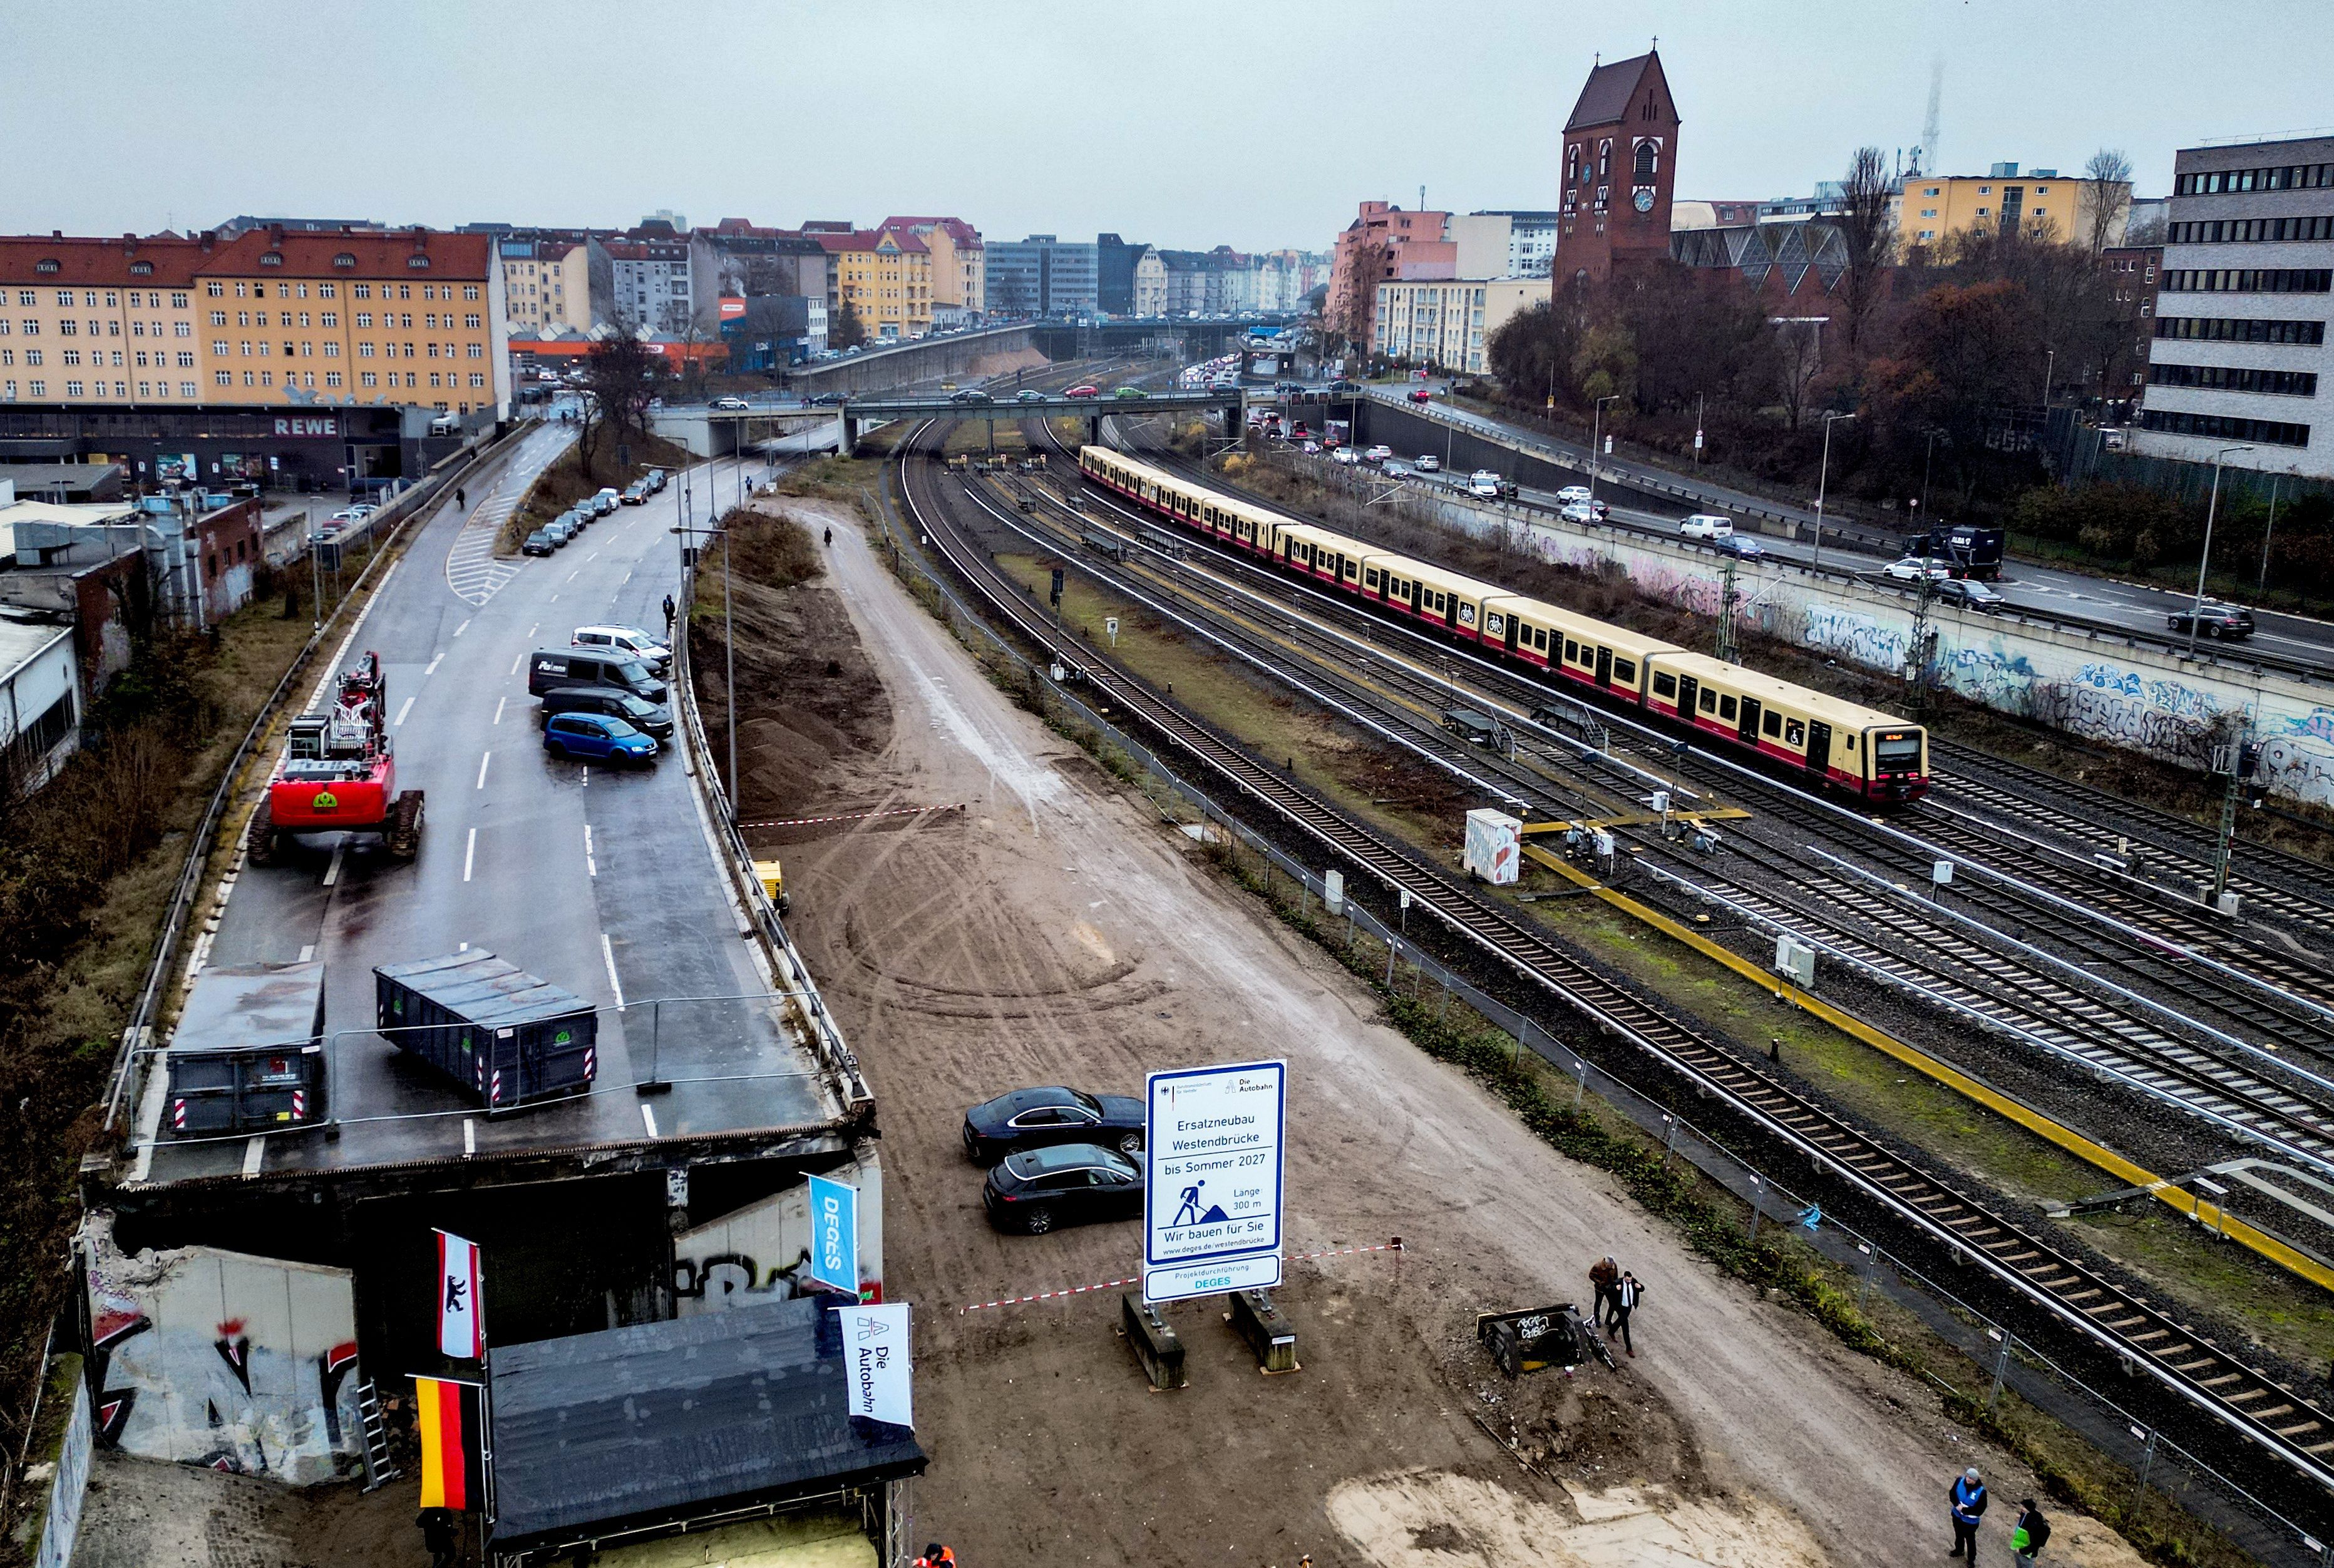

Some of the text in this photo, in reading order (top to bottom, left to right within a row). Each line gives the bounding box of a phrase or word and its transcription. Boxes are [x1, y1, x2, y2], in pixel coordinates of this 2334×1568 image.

[274, 419, 337, 434] REWE
[1239, 1084, 1273, 1093] Autobahn
[1178, 1115, 1255, 1131] Ersatzneubau
[1173, 1133, 1260, 1151] Westendbrücke
[1165, 1154, 1265, 1175] bis Sommer 2027
[1233, 1201, 1249, 1210] 300
[824, 1196, 841, 1271] DEGES
[1164, 1221, 1264, 1243] Wir bauen für Sie
[1195, 1276, 1231, 1289] DEGES
[876, 1345, 889, 1369] Die
[858, 1347, 874, 1413] Autobahn
